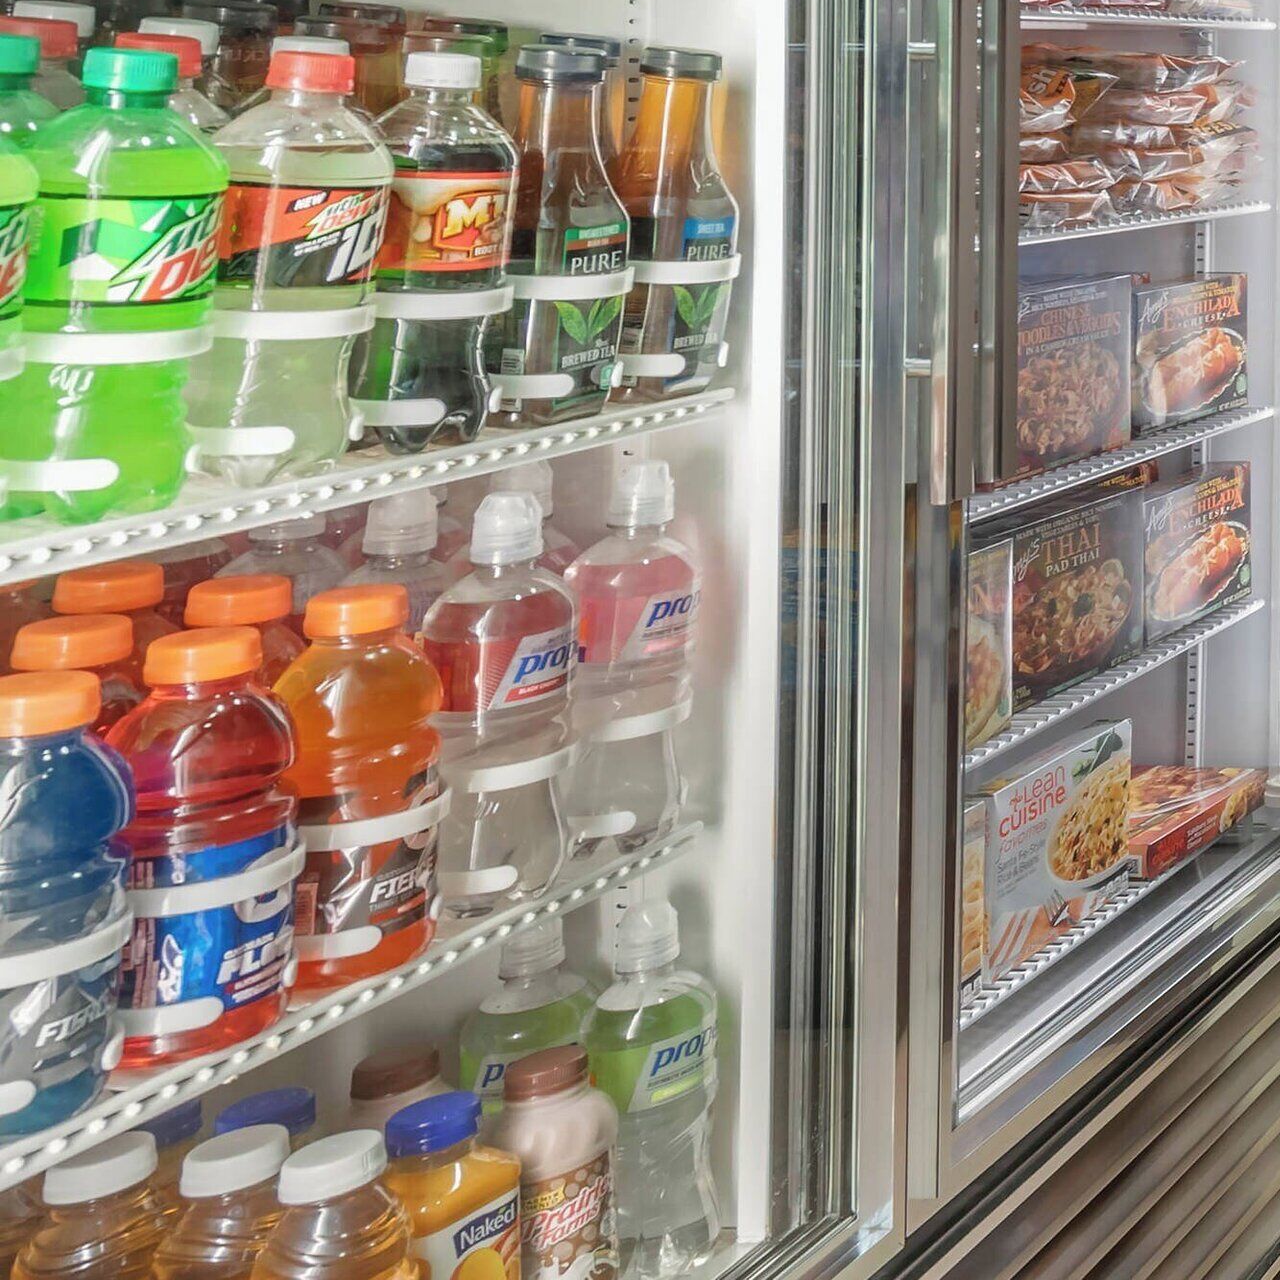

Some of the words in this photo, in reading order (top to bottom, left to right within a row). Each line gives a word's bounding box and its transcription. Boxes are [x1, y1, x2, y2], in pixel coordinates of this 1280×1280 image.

[570, 249, 624, 275] PURE
[1164, 294, 1241, 333] ENCHILADA
[1041, 523, 1101, 565] THAI
[1046, 560, 1069, 578] PAD
[1073, 547, 1101, 567] THAI
[1023, 765, 1066, 804] Lean
[457, 1202, 517, 1251] Naked
